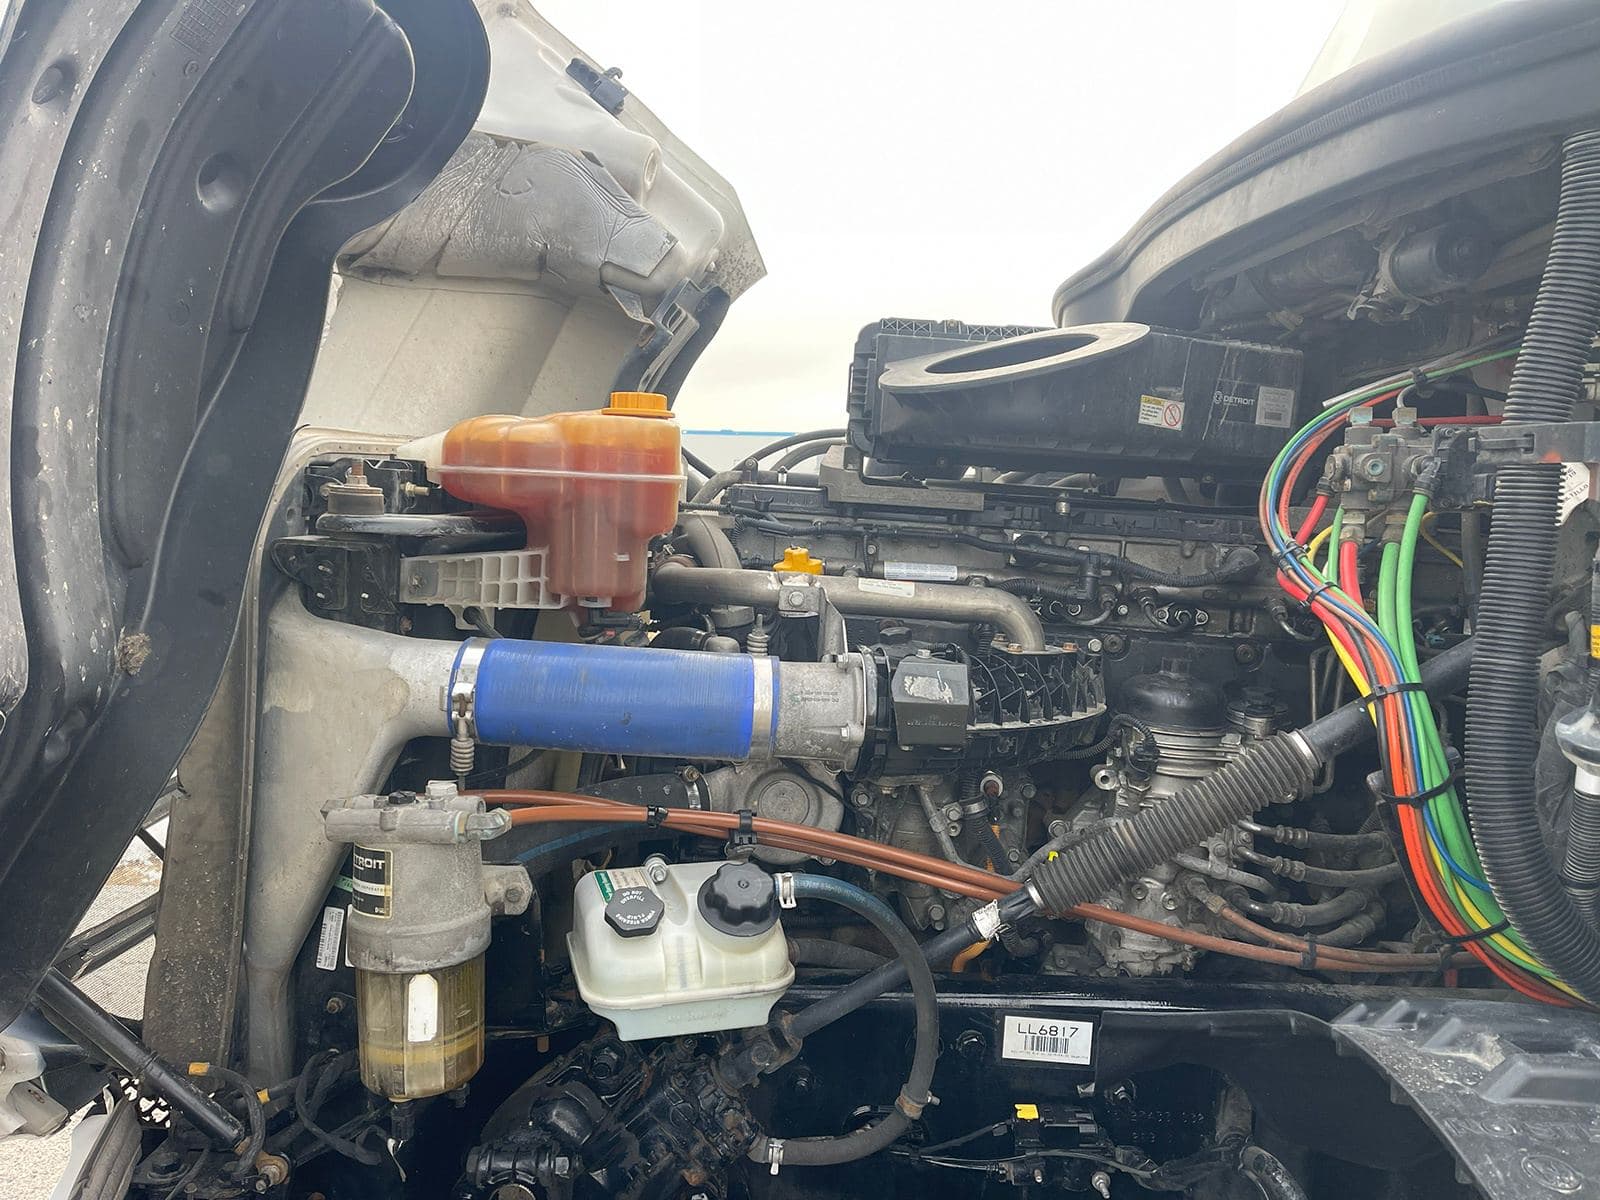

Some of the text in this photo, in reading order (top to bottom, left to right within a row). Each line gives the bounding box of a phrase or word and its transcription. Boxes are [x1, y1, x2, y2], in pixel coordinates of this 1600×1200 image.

[1223, 395, 1256, 406] DETROIT
[354, 854, 386, 870] TROIT
[1018, 1022, 1079, 1038] LL6817
